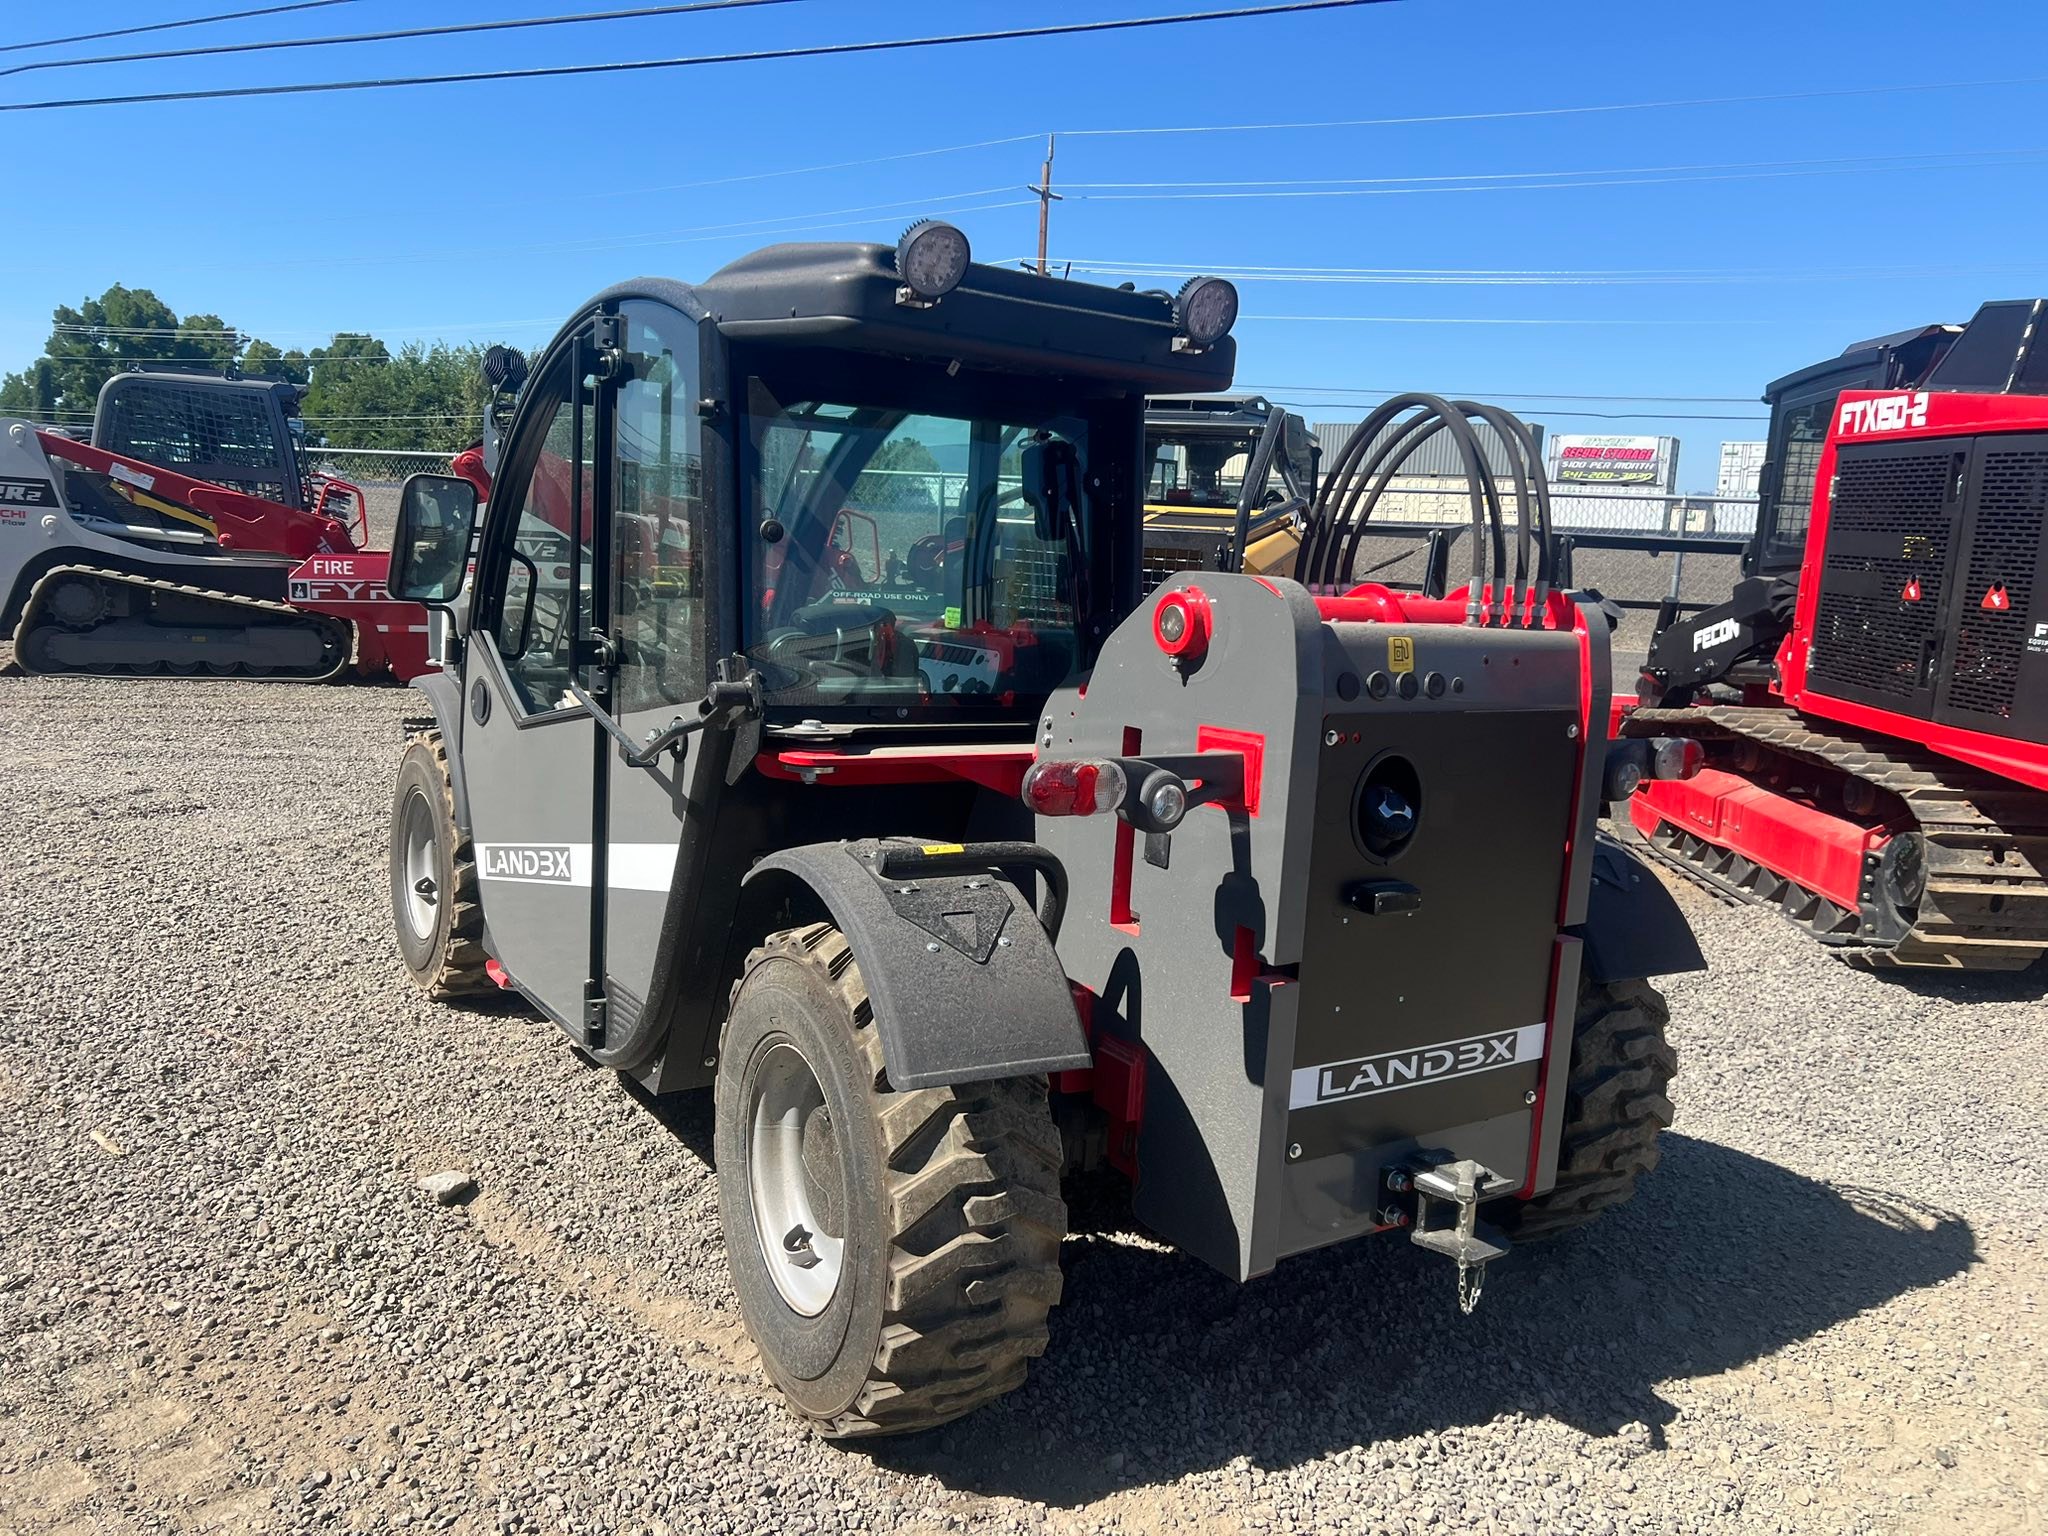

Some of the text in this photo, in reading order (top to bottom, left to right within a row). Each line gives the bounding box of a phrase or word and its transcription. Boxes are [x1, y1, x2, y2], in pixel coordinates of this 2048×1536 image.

[1838, 392, 1930, 435] FTX150-2
[1562, 447, 1655, 461] SECURE STORAGE
[1561, 461, 1656, 471] $100 PER MONTH
[313, 560, 355, 575] FIRE
[1693, 617, 1740, 653] FECON
